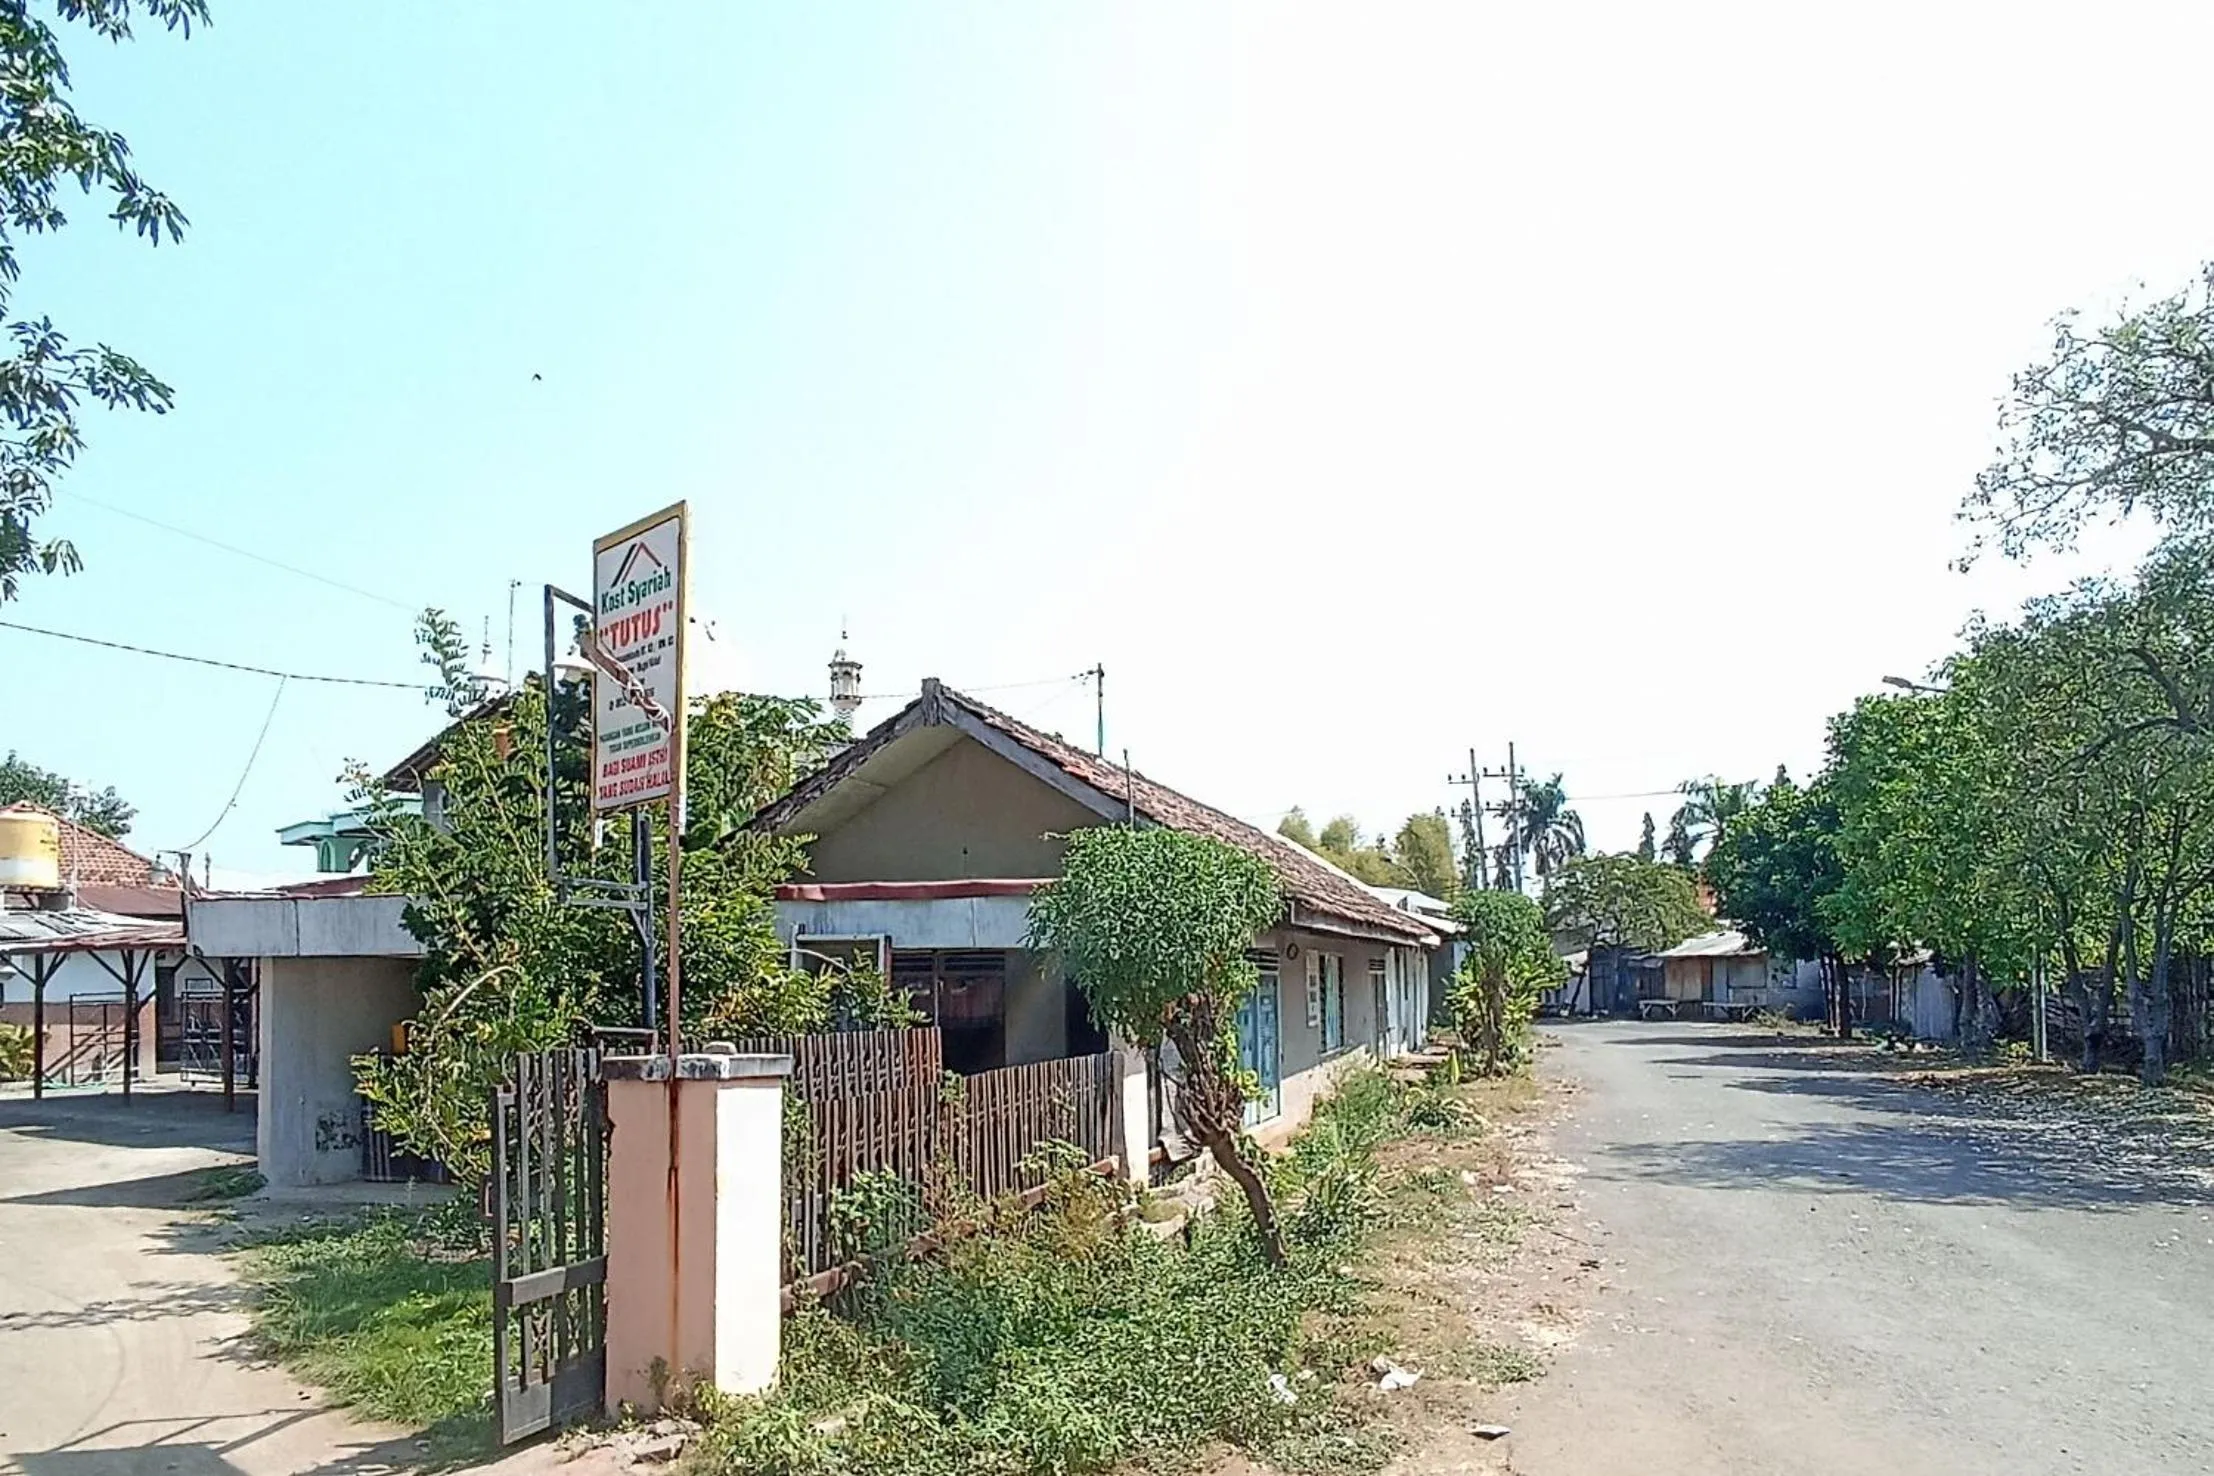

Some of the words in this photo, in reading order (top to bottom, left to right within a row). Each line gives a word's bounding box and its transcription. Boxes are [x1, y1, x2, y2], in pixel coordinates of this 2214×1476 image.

[601, 586, 625, 615] Kost
[627, 566, 672, 606] Syariah
[598, 600, 674, 650] "TUTUS"
[621, 753, 646, 773] SUAMI
[599, 782, 617, 800] YANG
[619, 777, 644, 796] SUDAH
